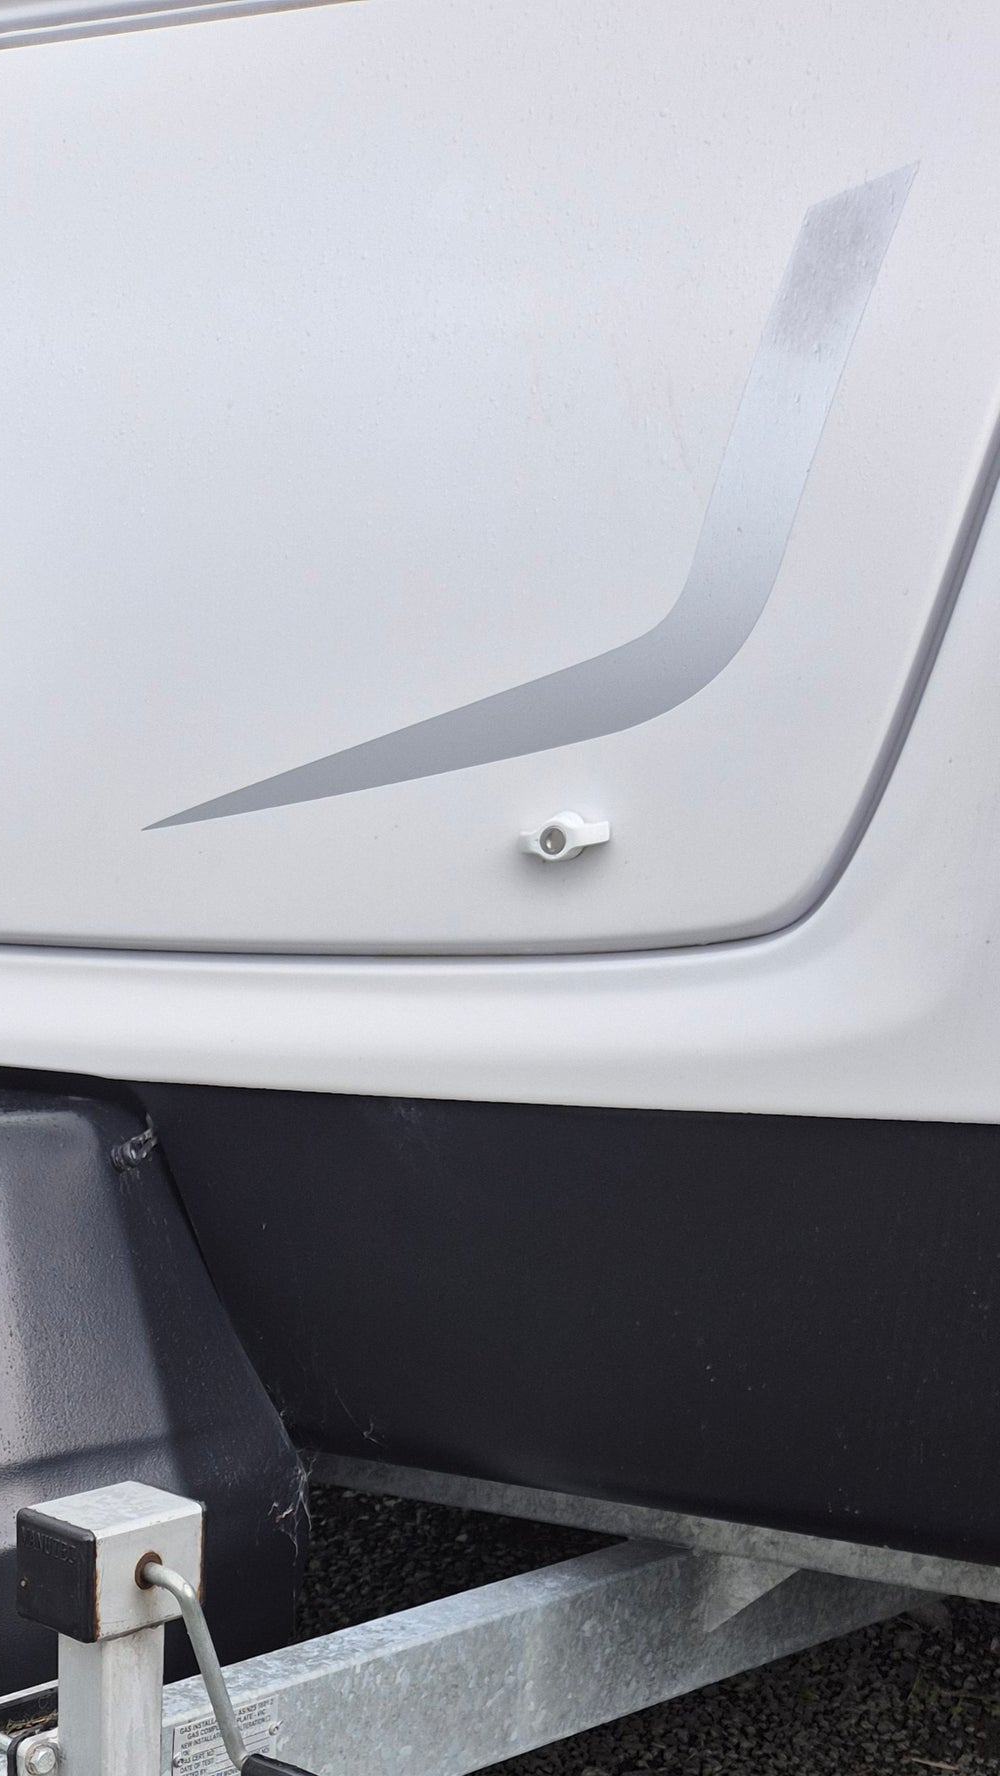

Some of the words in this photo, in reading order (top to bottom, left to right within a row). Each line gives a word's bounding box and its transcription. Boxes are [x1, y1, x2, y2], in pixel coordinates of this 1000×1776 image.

[180, 1725, 192, 1735] GAS
[187, 1731, 199, 1740] GAS
[200, 1724, 220, 1736] COMPL
[180, 1764, 193, 1774] DATE
